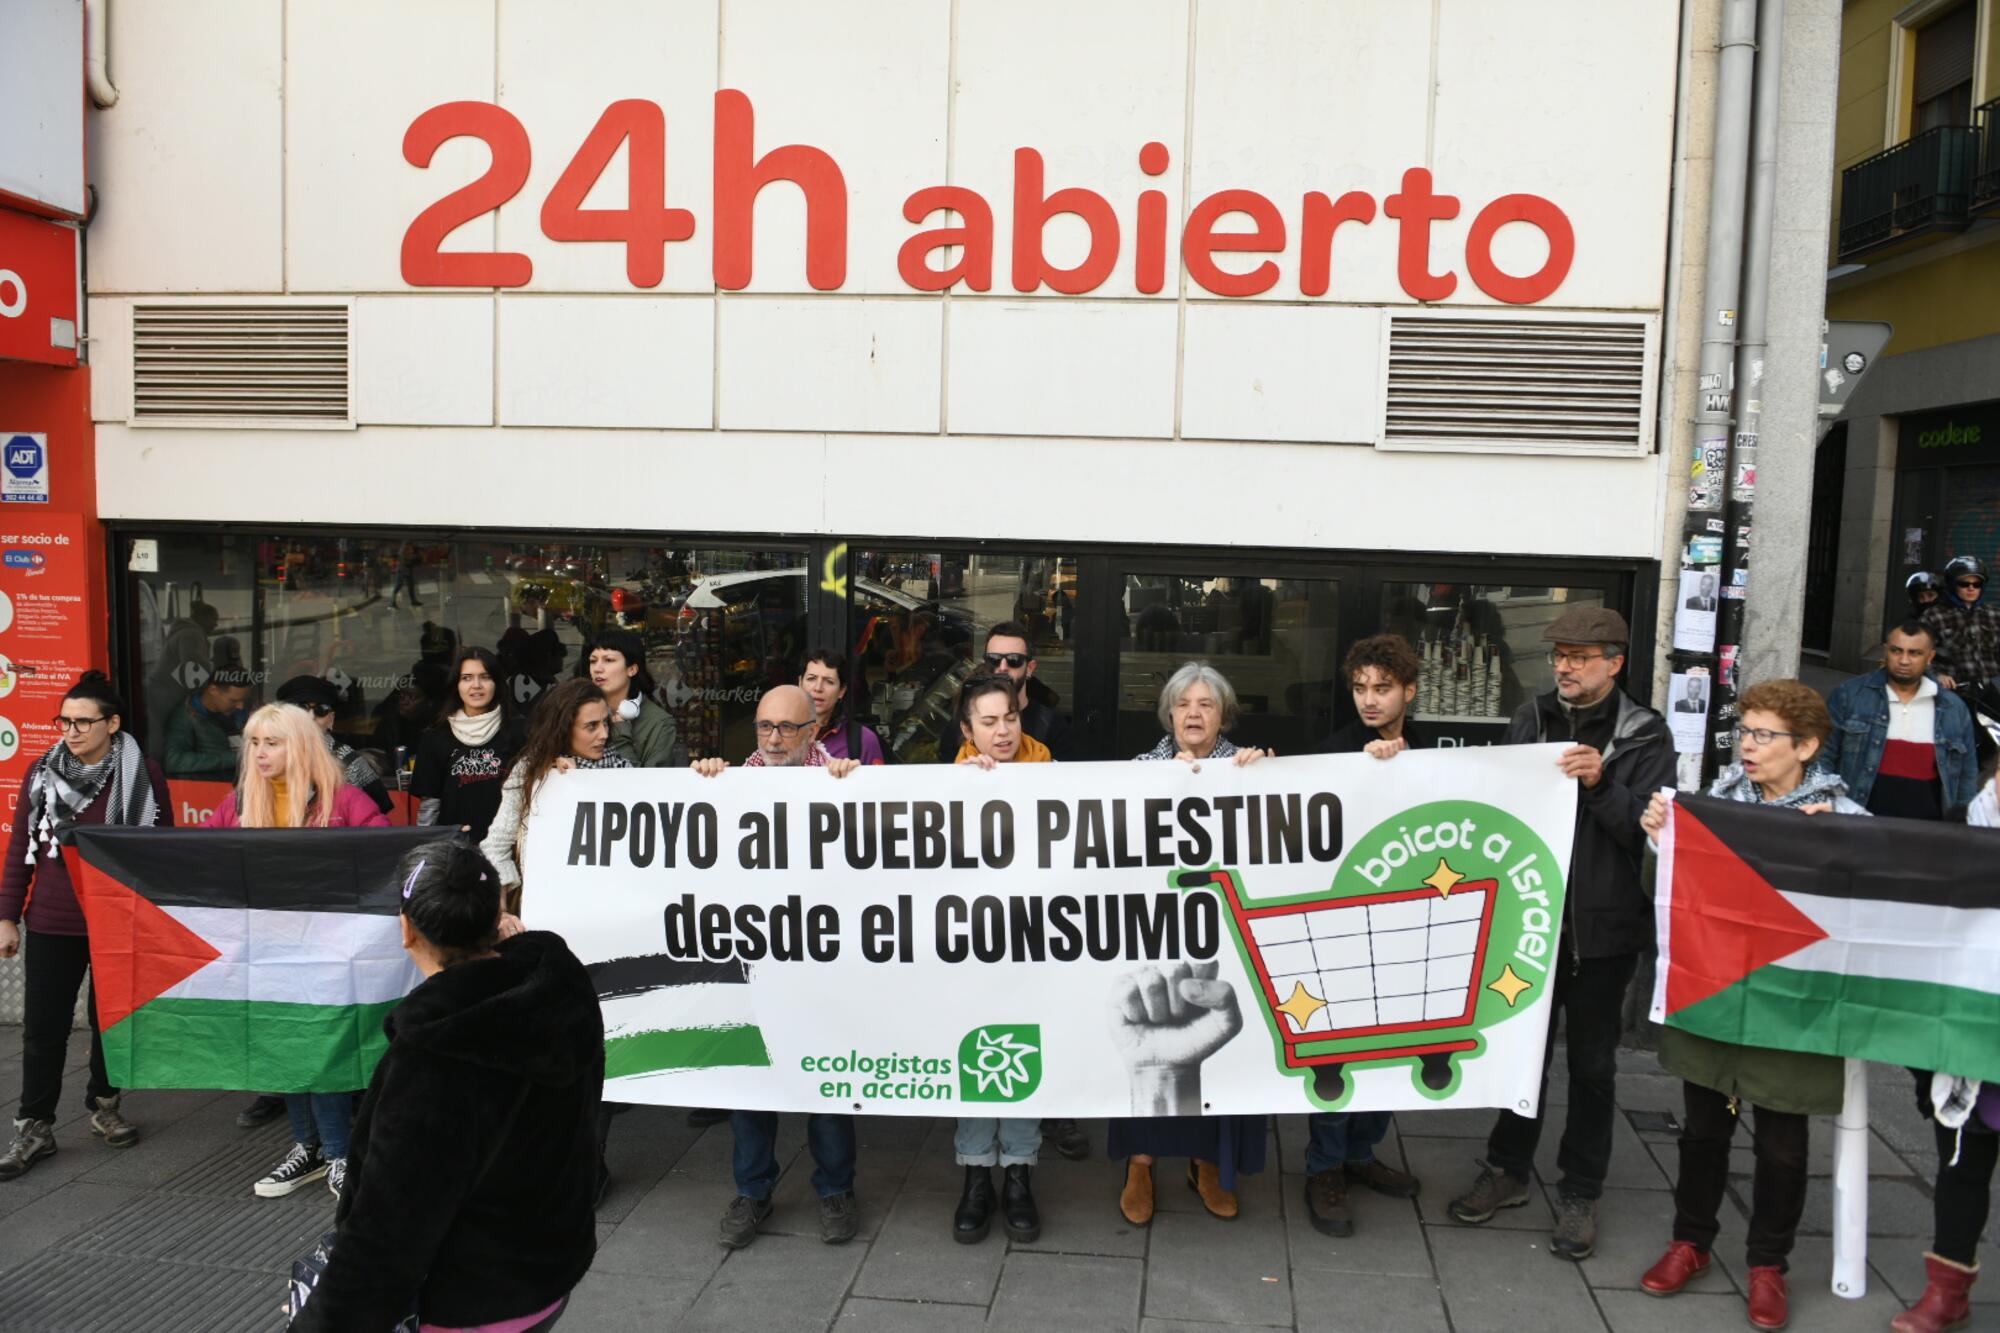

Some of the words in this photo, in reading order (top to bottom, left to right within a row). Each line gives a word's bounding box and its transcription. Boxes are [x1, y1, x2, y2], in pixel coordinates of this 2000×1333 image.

[401, 89, 847, 290] 24h
[897, 141, 1575, 304] abierto
[1919, 421, 1981, 449] codere
[11, 450, 37, 464] ADT
[1, 535, 19, 544] ser
[22, 532, 52, 545] socio
[54, 533, 70, 545] de
[14, 555, 30, 564] Club
[58, 673, 71, 681] IVA
[214, 669, 272, 686] market
[356, 673, 416, 691] market
[700, 686, 761, 702] market
[567, 801, 718, 869] APOYO
[738, 802, 788, 870] al
[809, 799, 1015, 870] PUEBLO
[1037, 791, 1343, 869] PALESTINO
[1353, 817, 1477, 888] boicot
[1482, 833, 1512, 863] a
[1507, 852, 1553, 973] Israel
[663, 893, 840, 963] desde
[861, 894, 913, 963] el
[935, 891, 1219, 963] CONSUMO
[800, 1049, 952, 1081] ecologistas
[820, 1081, 858, 1099] en
[863, 1076, 953, 1101] acción
